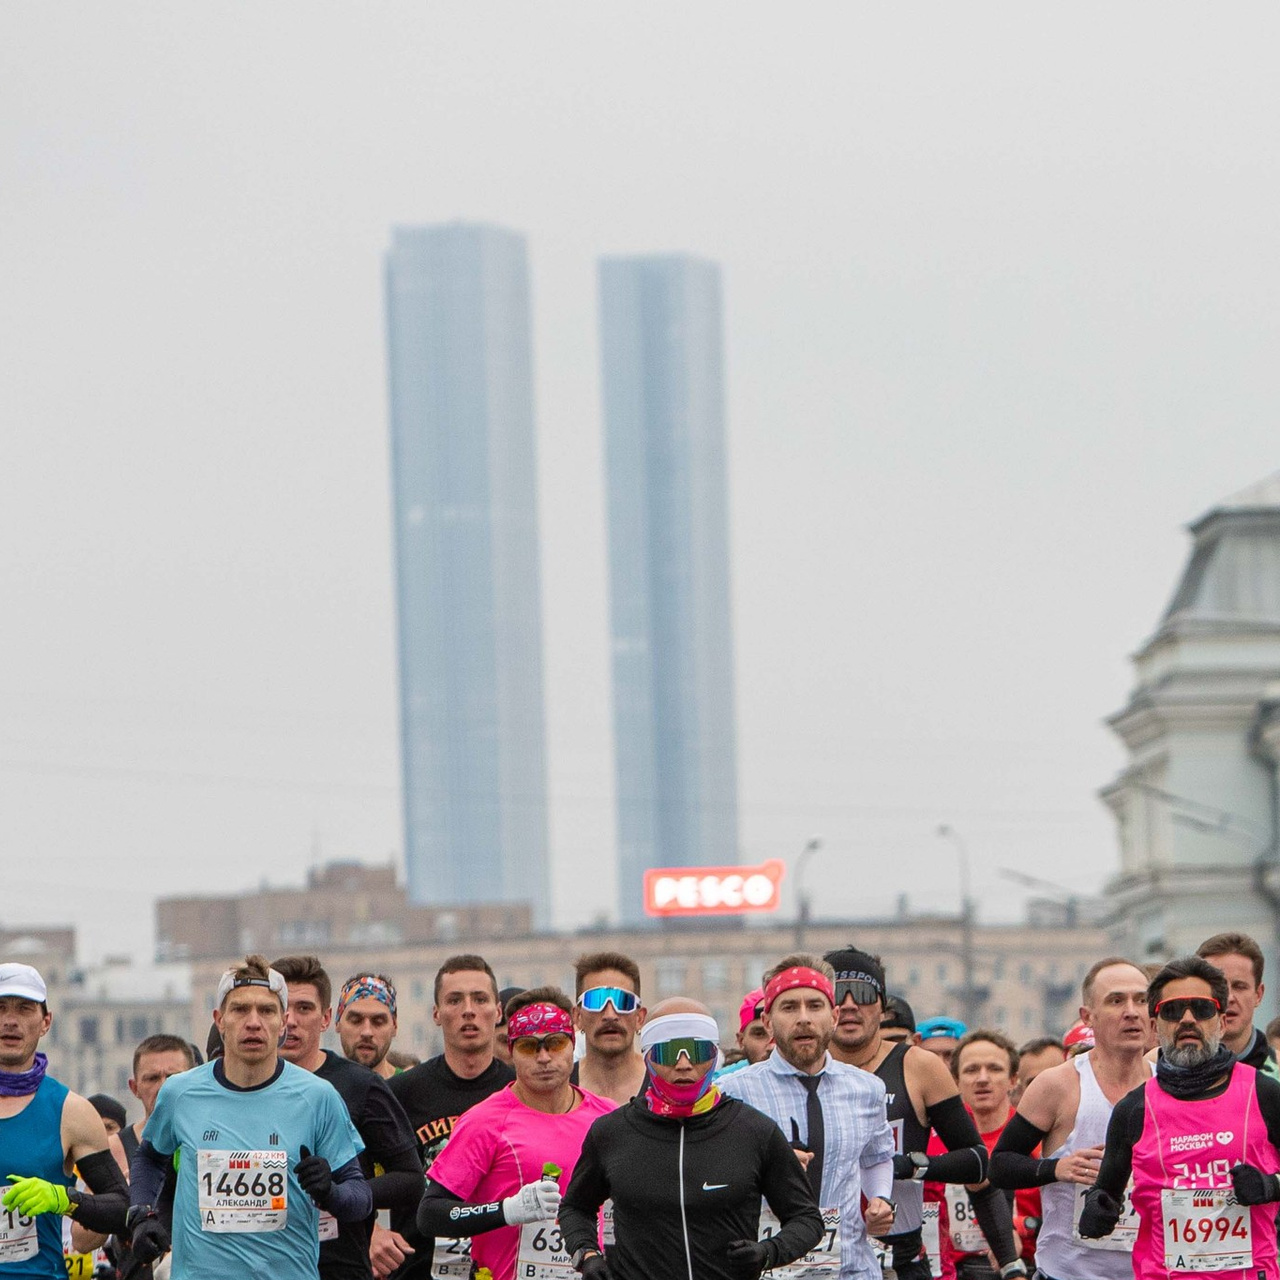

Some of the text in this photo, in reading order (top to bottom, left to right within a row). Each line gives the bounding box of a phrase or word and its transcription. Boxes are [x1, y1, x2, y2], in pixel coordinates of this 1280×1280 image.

[1170, 1132, 1213, 1145] МАРАФОН
[1170, 1140, 1207, 1153] МОСКВА
[202, 1172, 285, 1197] 14668
[215, 1199, 268, 1208] АЛЕКСАНДР
[1168, 1216, 1248, 1244] 16994
